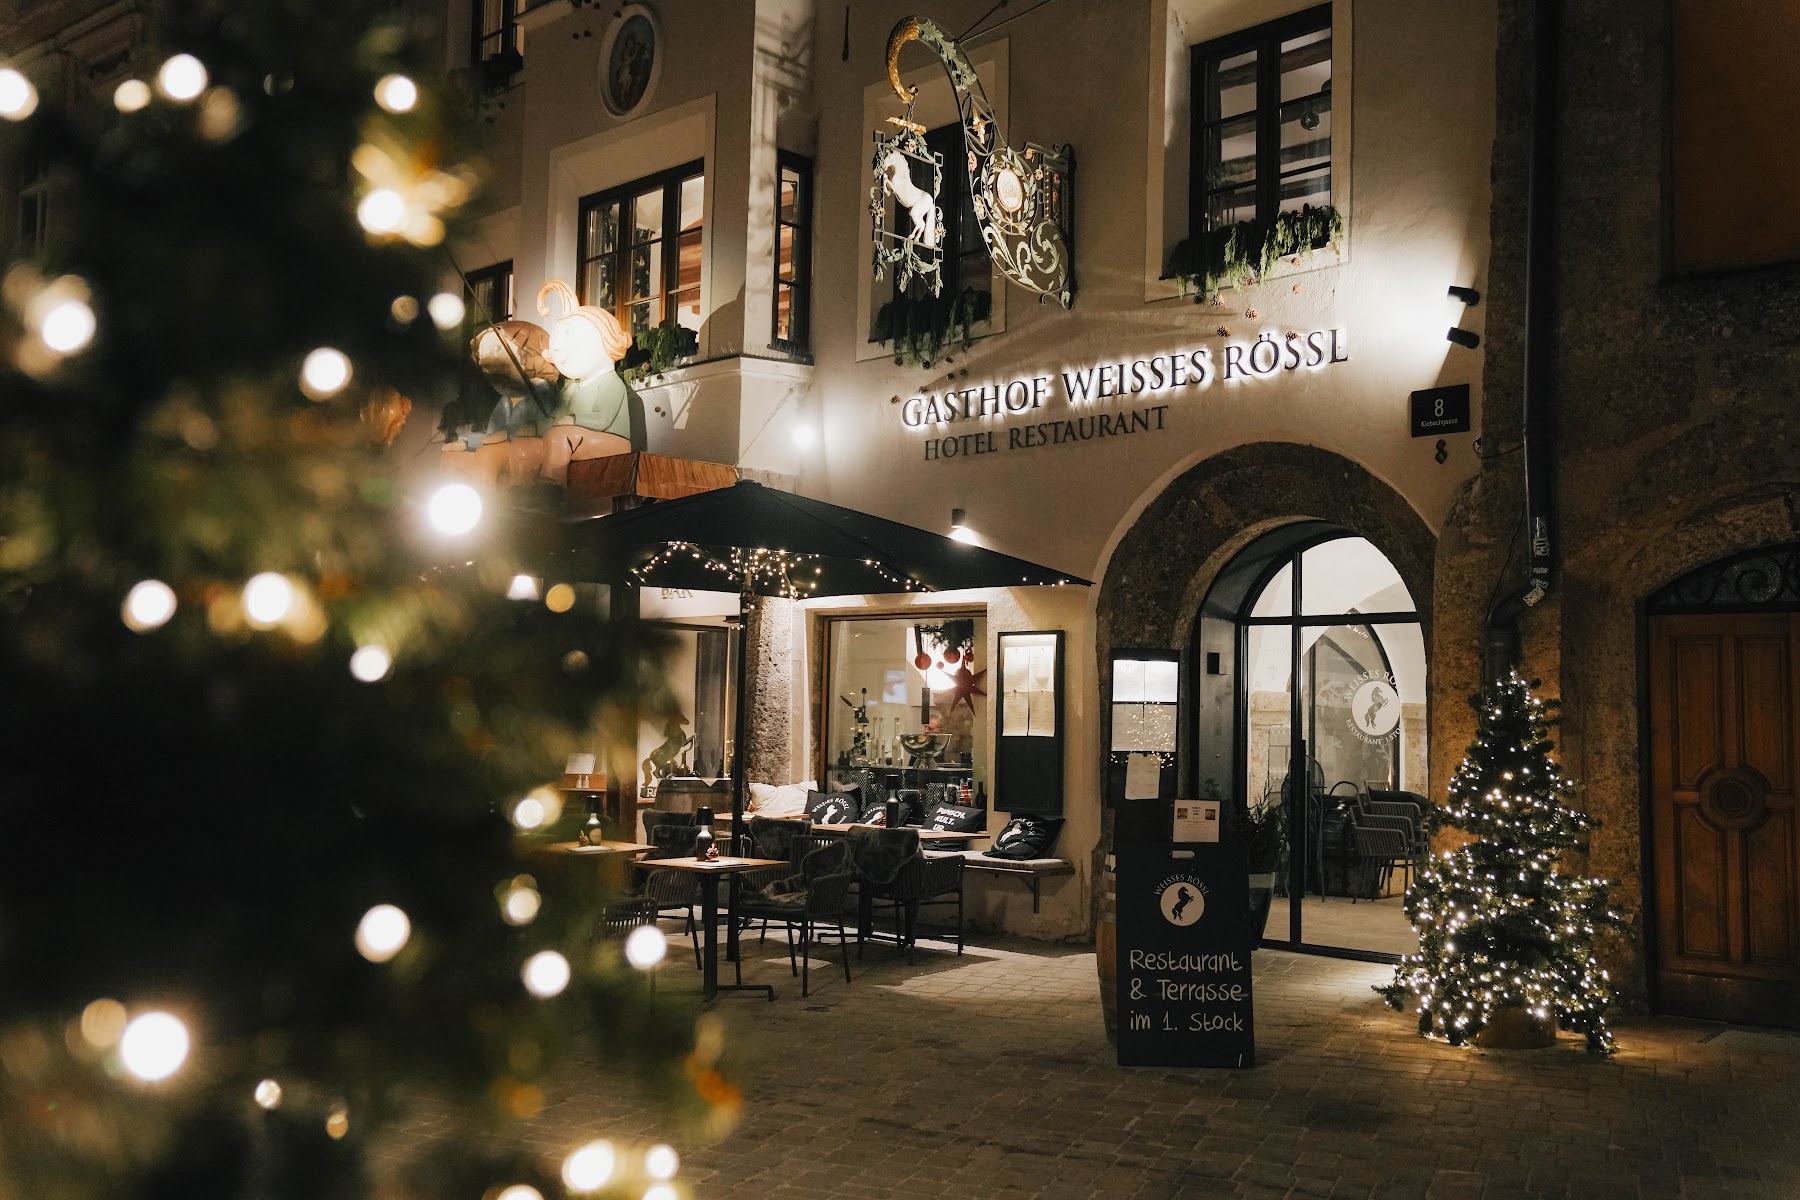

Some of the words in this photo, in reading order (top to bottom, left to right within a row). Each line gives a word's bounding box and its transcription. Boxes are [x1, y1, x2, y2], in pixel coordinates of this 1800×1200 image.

[902, 377, 1048, 428] GASTHOF
[1062, 350, 1207, 403] WEISSES
[1224, 328, 1348, 380] RÖSSL
[1434, 398, 1444, 417] 8
[924, 432, 997, 461] HOTEL
[1009, 406, 1169, 450] RESTAURANT
[1344, 670, 1380, 701] WEISSES
[1345, 719, 1382, 745] RESTAURANT
[1154, 874, 1185, 895] WEISSES
[1187, 875, 1210, 896] RÖSSL
[1130, 950, 1243, 972] Restaurant
[1130, 977, 1147, 1001] &
[1156, 979, 1246, 1003] Terrasse
[1130, 1010, 1150, 1031] im
[1162, 1012, 1178, 1031] 1.
[1189, 1011, 1244, 1032] Stock
